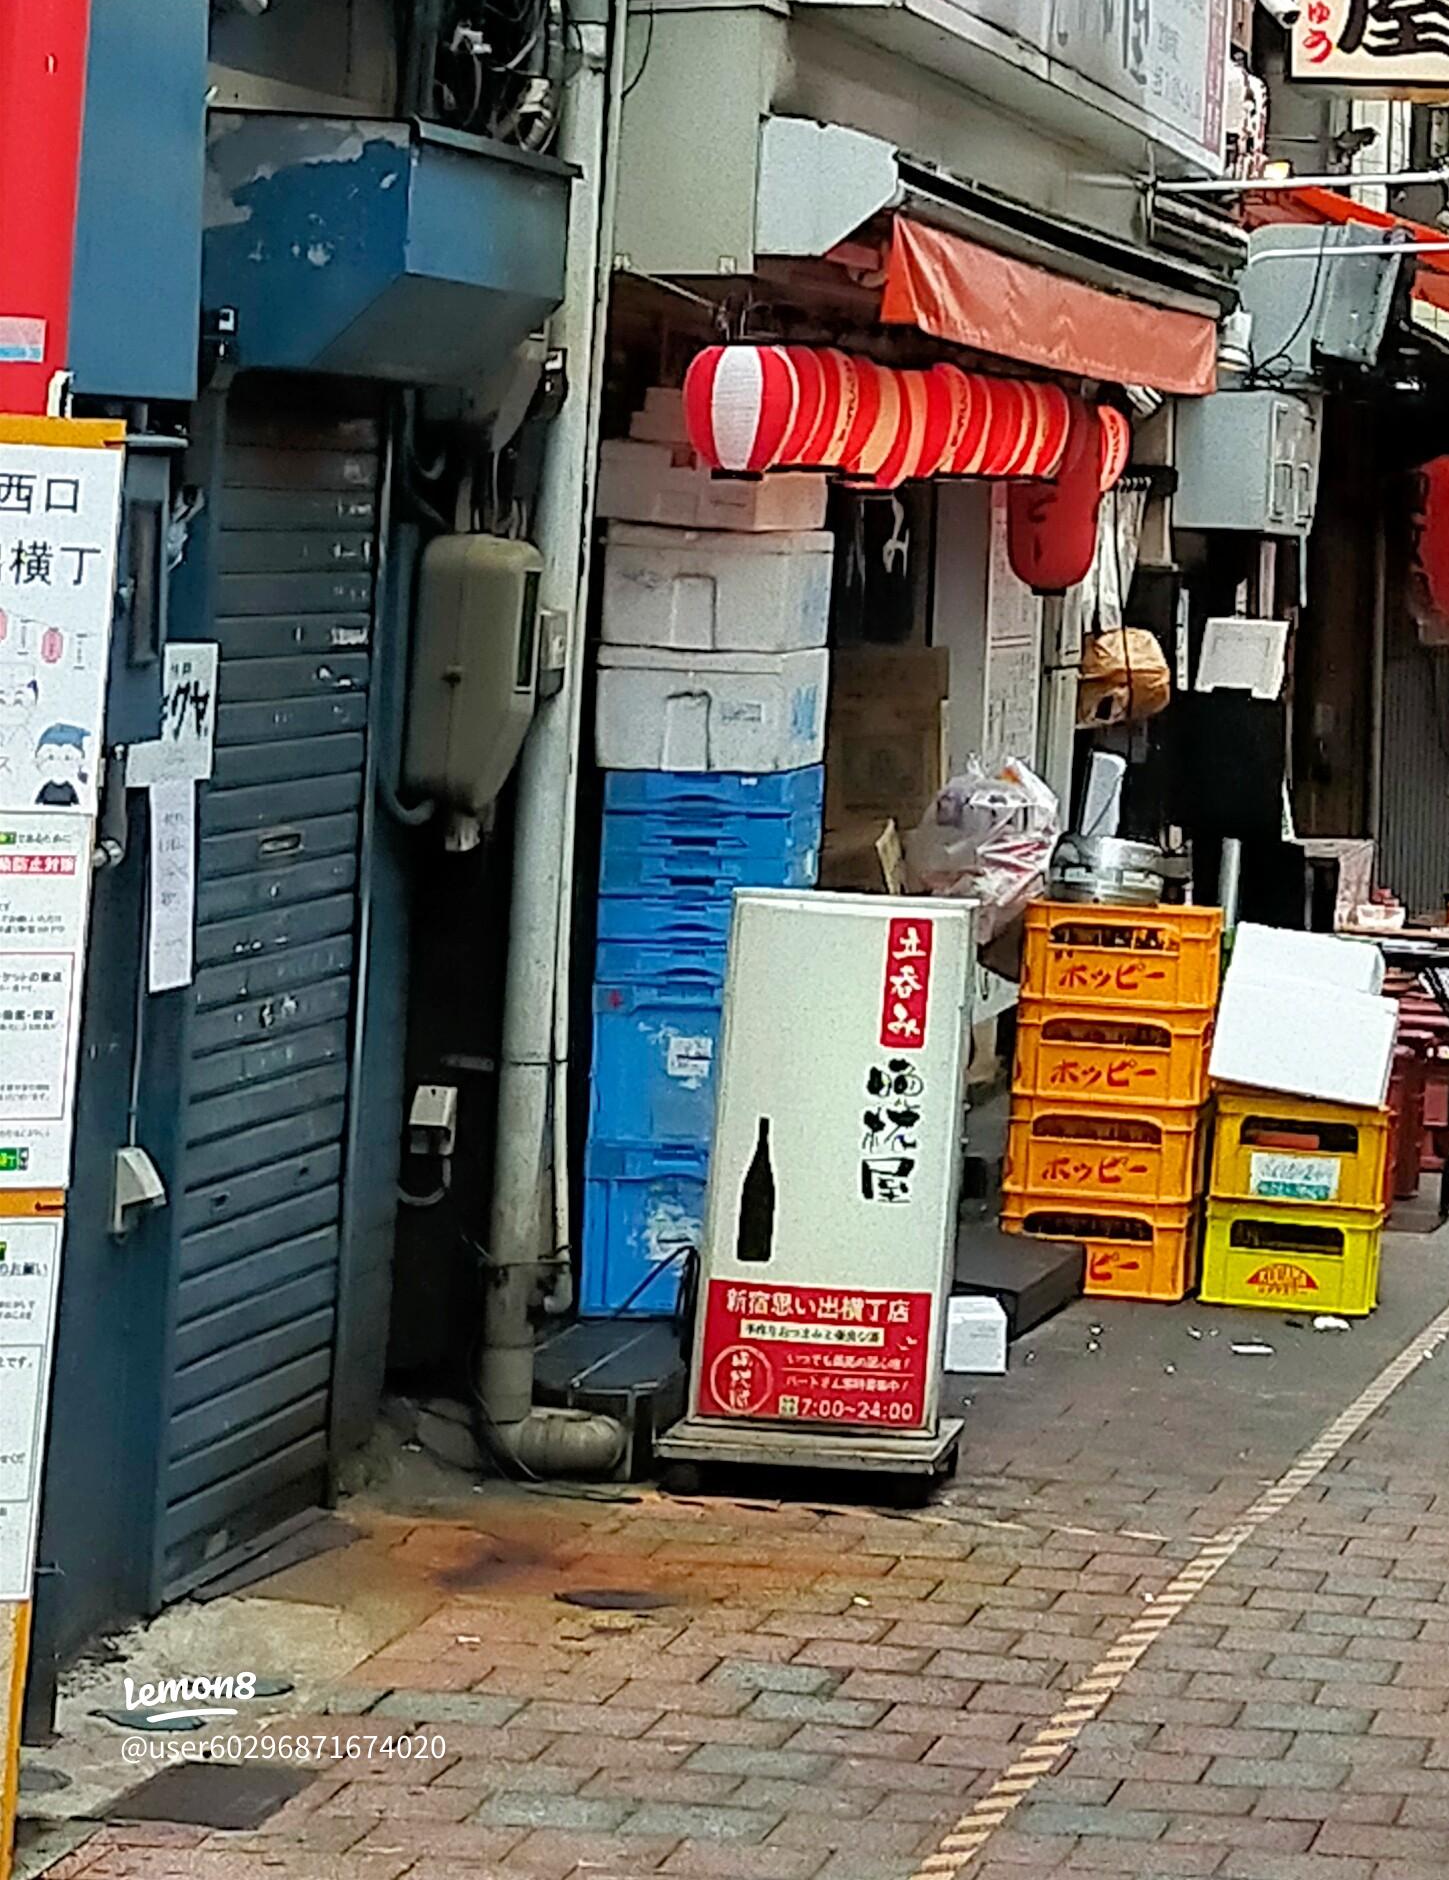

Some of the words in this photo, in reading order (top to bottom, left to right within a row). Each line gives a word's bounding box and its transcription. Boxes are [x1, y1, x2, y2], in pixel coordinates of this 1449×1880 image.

[0, 473, 80, 514] 西口
[1059, 962, 1166, 990] ホッピー
[1050, 1058, 1157, 1088] ホッピー
[1041, 1156, 1149, 1184] ホッピー
[1088, 1252, 1140, 1281] ピー
[726, 1287, 911, 1323] 新宿思い出横丁店
